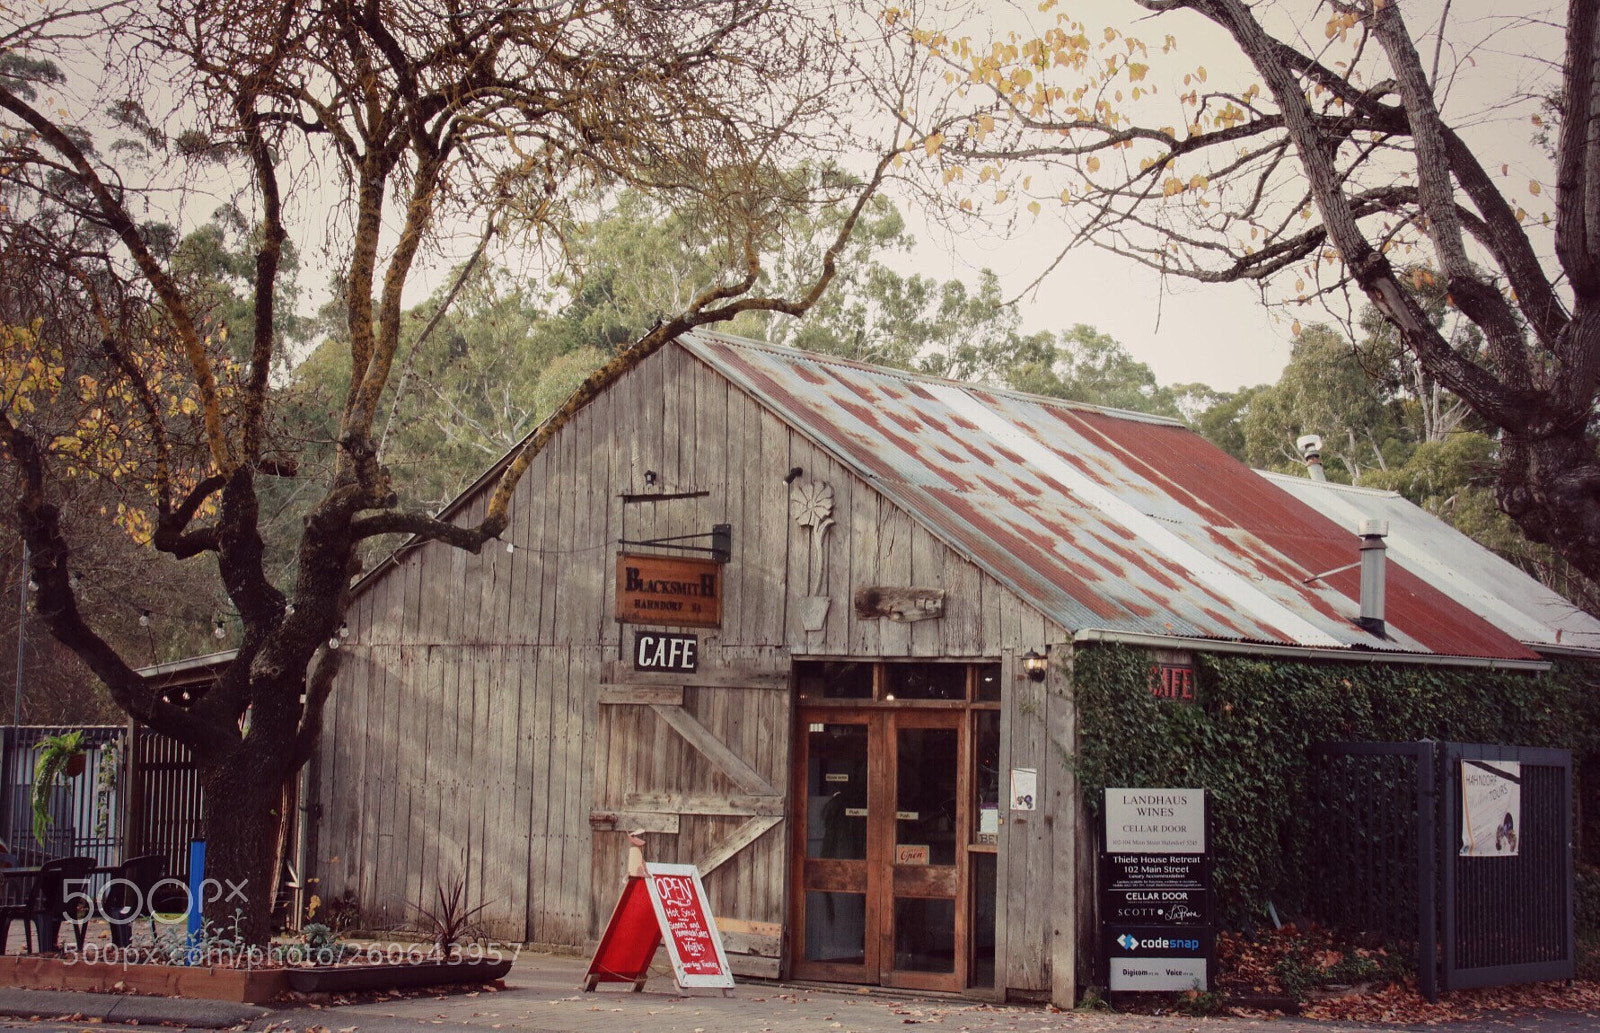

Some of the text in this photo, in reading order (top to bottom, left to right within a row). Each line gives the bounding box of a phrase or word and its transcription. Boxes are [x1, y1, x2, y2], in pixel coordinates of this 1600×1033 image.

[625, 566, 716, 597] BLACKSMITH
[634, 599, 683, 611] HAHNDORF
[638, 636, 697, 668] CAFE
[1488, 783, 1508, 800] TOURS
[1123, 795, 1187, 805] LANDHAUS
[1137, 807, 1174, 817] WINES
[1113, 855, 1138, 864] Thiele
[1141, 865, 1161, 873] Main
[1125, 892, 1188, 900] CELLAR DOOR
[665, 908, 680, 918] Hot
[1118, 908, 1155, 916] SCOTT
[1141, 937, 1199, 950] codesnap
[1122, 969, 1148, 977] Digicom
